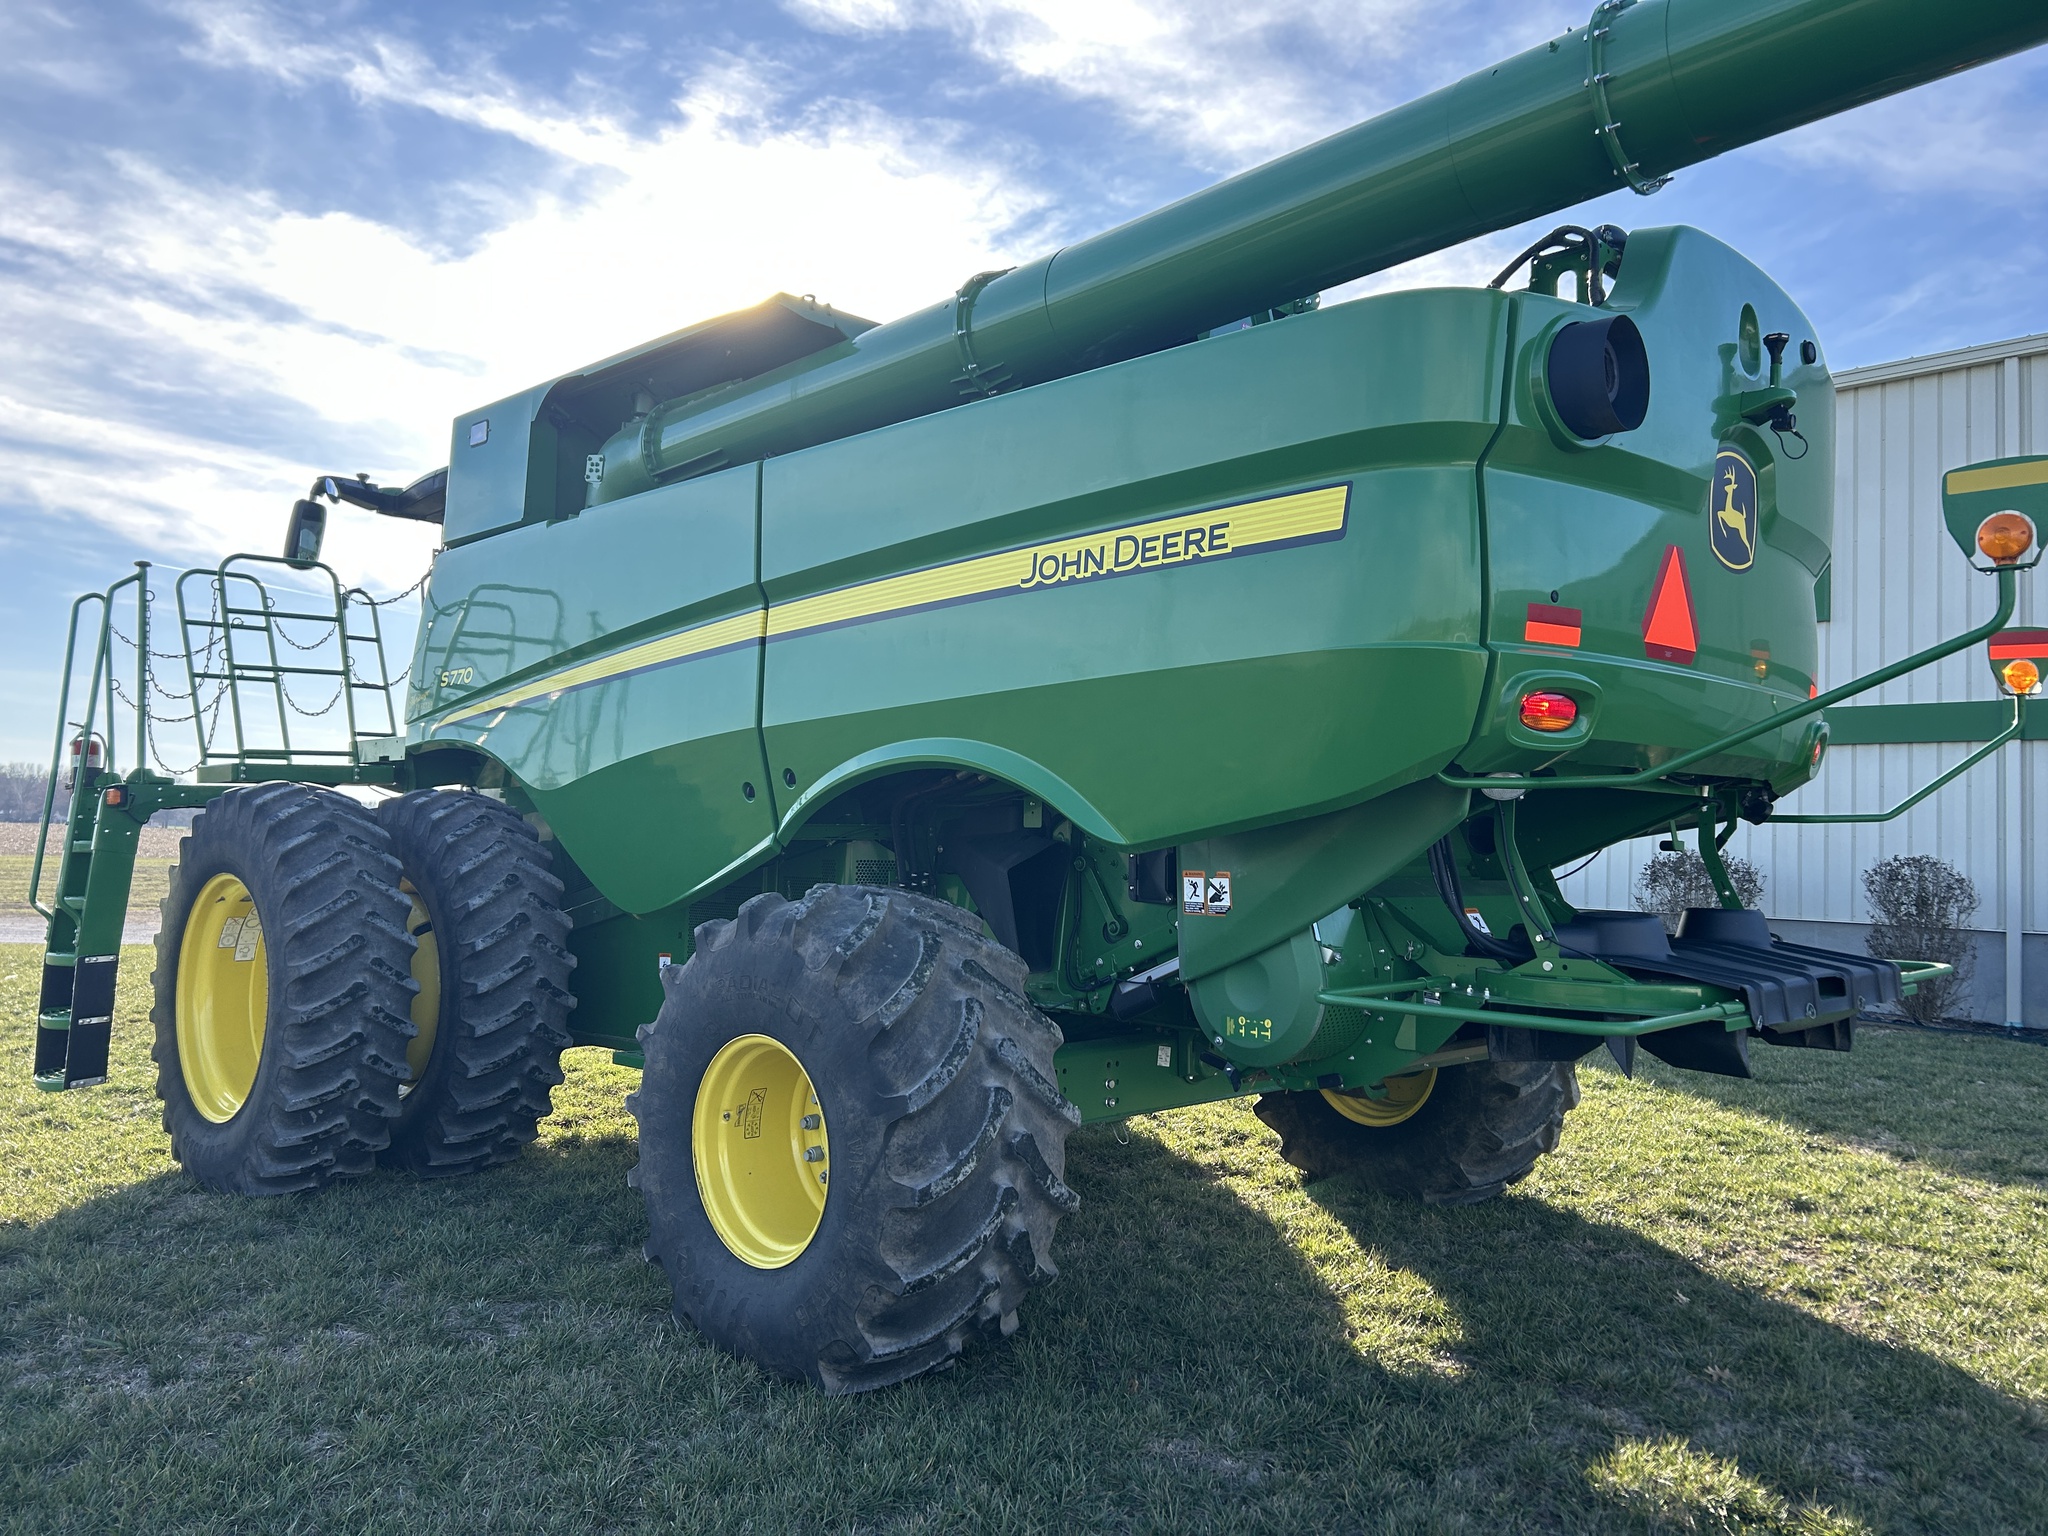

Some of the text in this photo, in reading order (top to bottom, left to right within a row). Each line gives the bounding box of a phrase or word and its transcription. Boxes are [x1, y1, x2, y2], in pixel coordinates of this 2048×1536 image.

[1020, 521, 1231, 586] JOHN DEERE
[440, 666, 474, 687] S770
